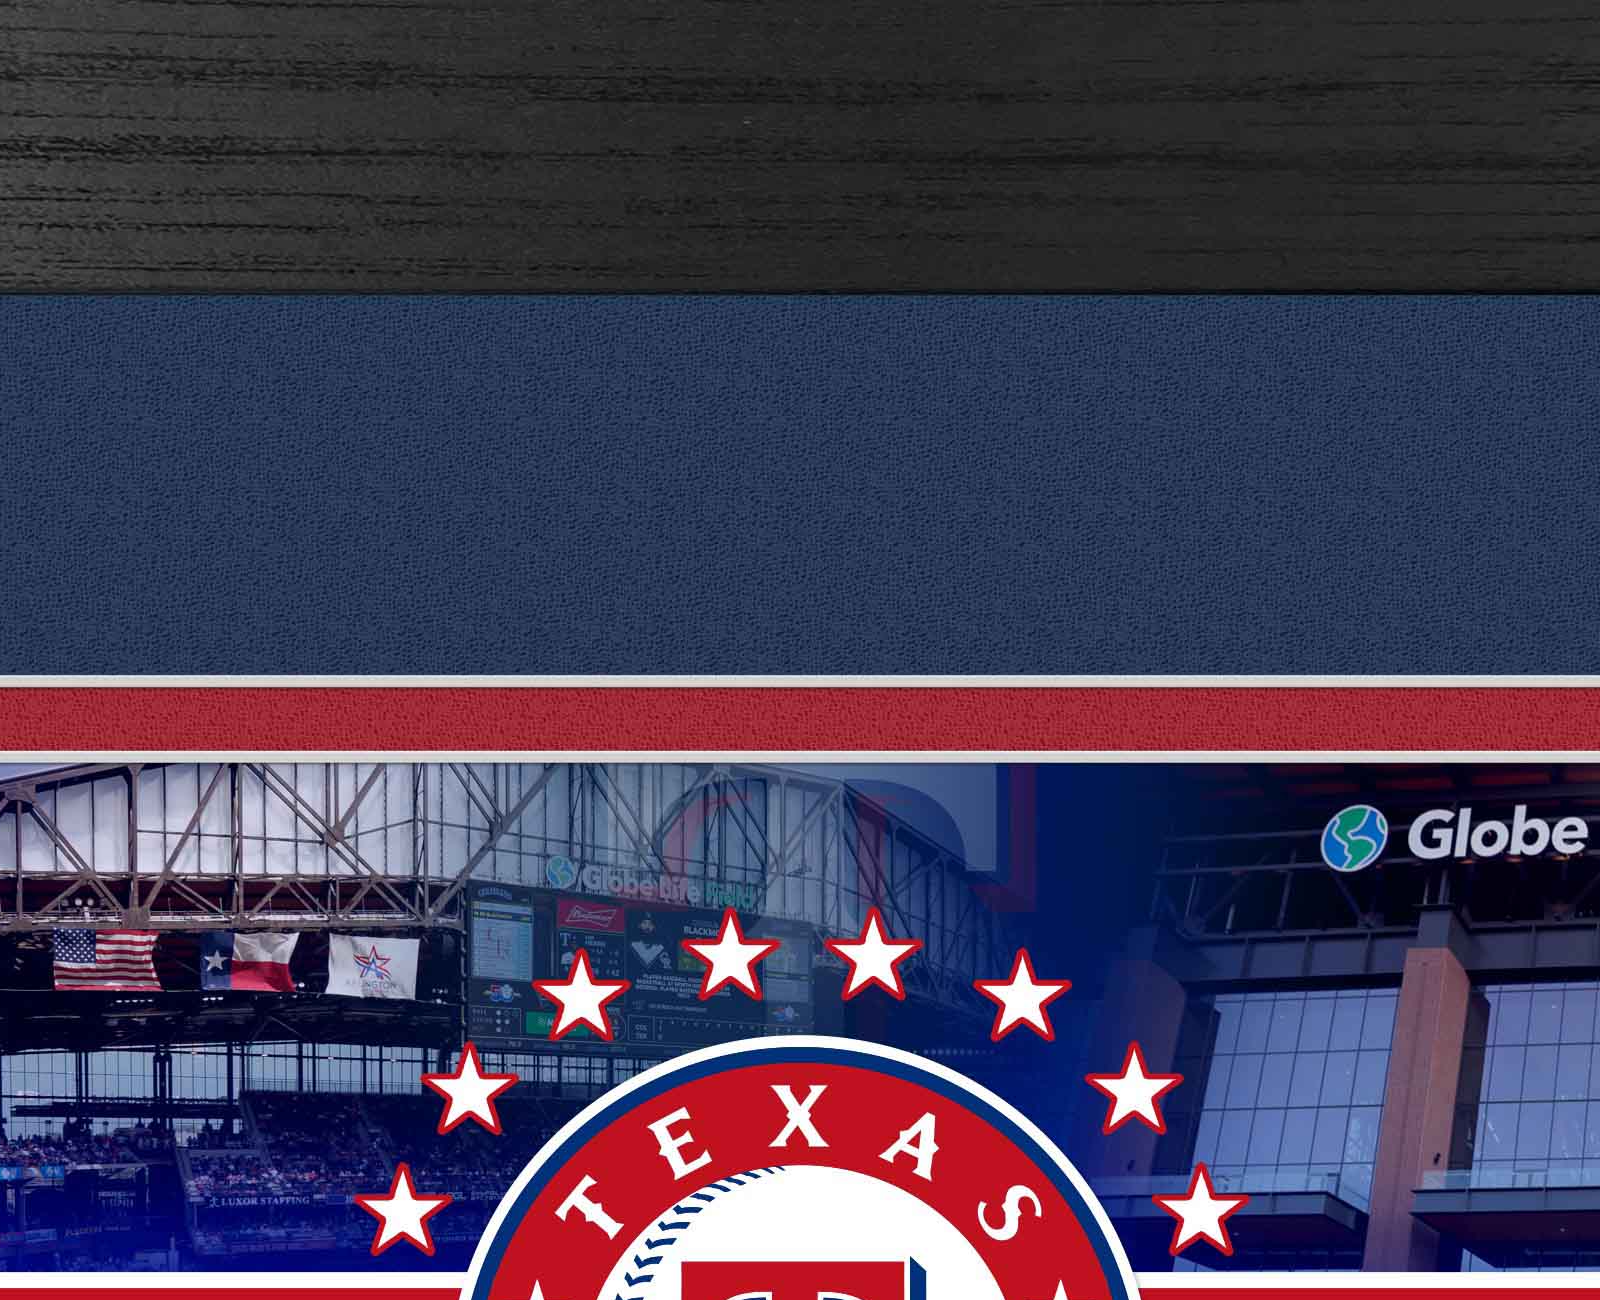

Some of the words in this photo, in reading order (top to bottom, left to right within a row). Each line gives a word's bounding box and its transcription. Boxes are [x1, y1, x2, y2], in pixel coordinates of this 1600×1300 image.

[1408, 805, 1588, 859] Globe
[554, 1085, 1042, 1241] TEXAS
[222, 1196, 258, 1207] LUXOR
[261, 1195, 310, 1206] STAFFING
